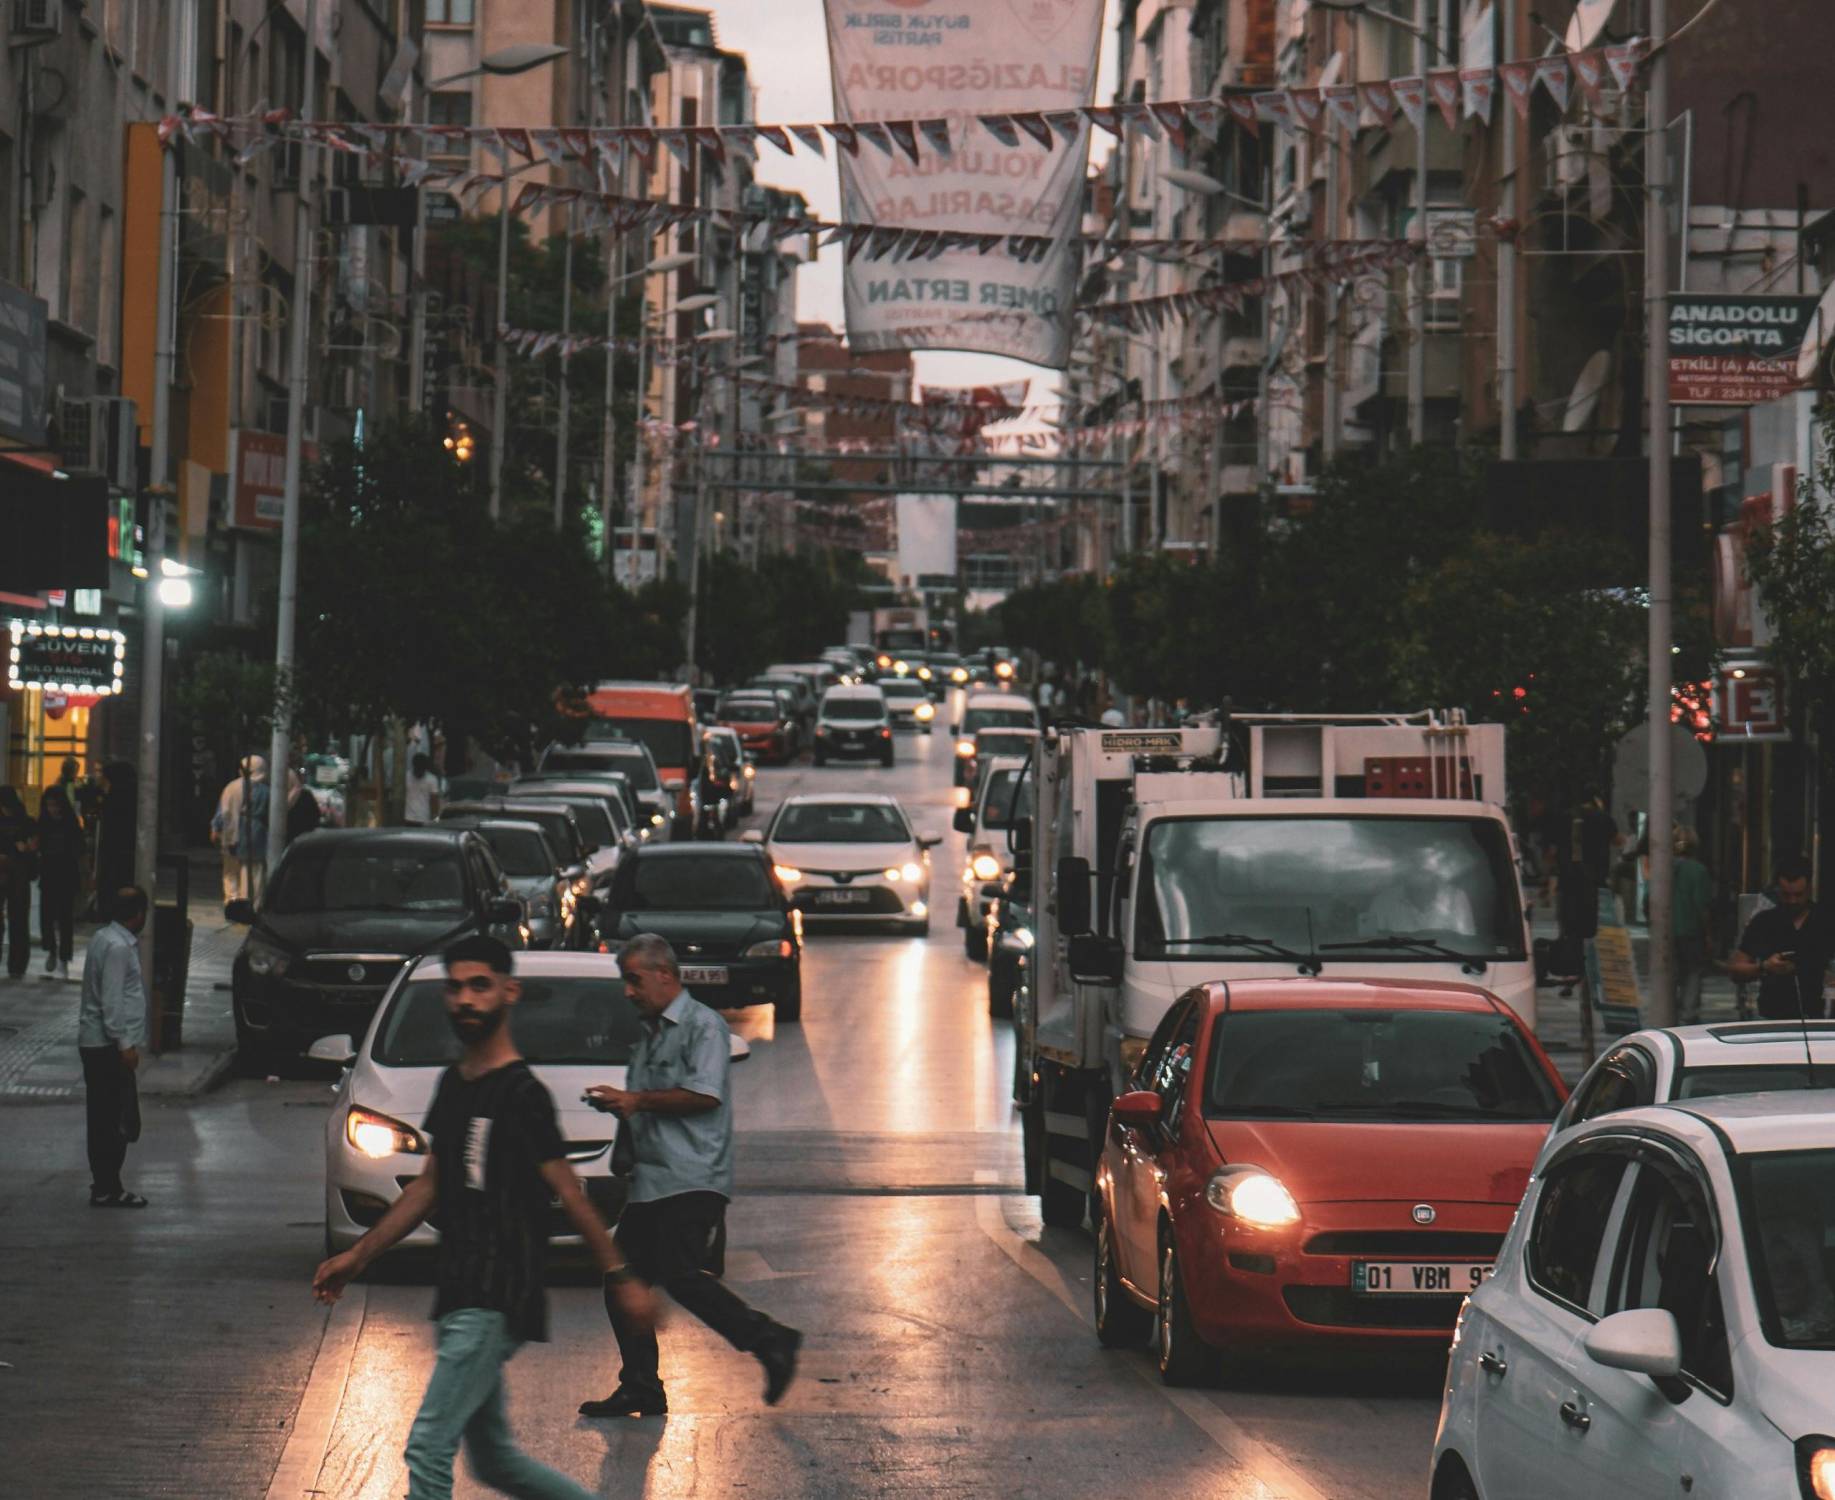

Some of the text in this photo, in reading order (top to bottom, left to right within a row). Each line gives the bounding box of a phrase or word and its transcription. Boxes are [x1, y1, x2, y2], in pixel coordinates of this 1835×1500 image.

[1670, 305, 1798, 324] ANADOLU
[1669, 324, 1783, 345] SİGORTA
[1670, 356, 1717, 371] ETKİLİ
[1688, 387, 1712, 398] TLF
[1368, 1266, 1392, 1289] 01
[1411, 1266, 1451, 1289] VBM
